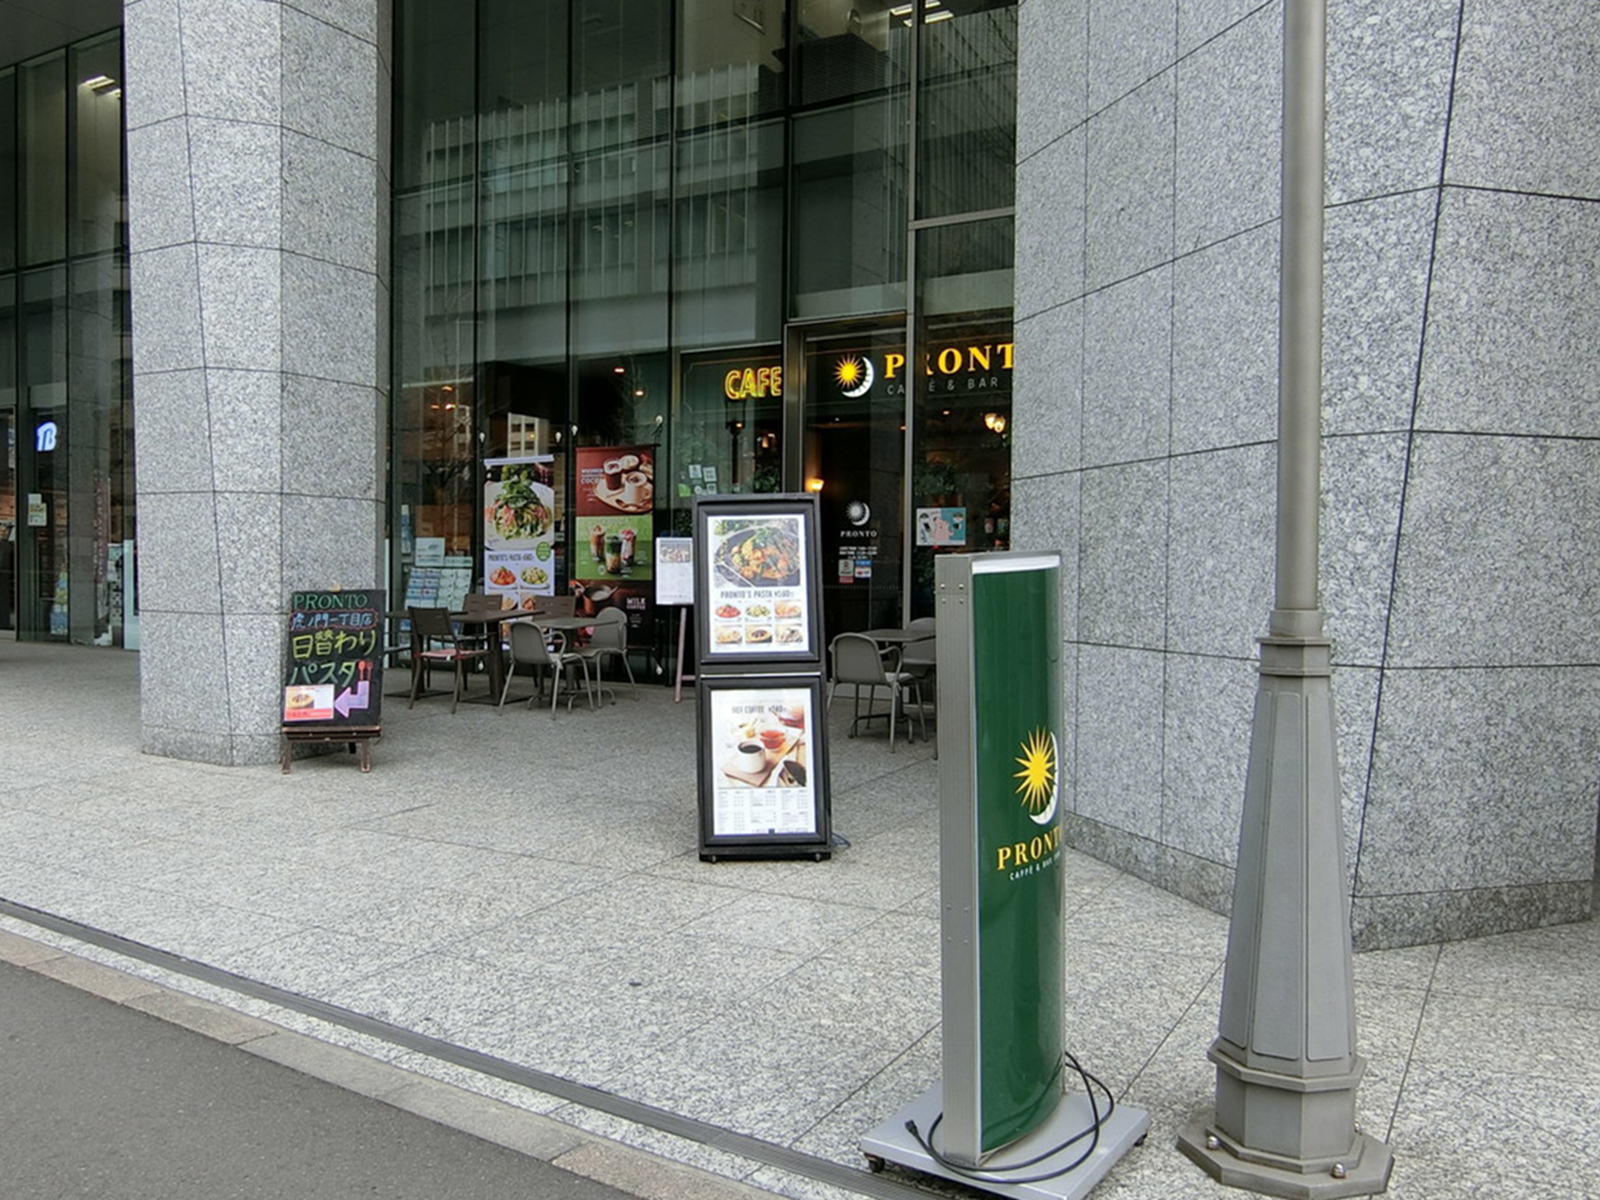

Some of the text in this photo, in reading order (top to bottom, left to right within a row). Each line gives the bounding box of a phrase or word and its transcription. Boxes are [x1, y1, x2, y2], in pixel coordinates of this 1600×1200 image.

[724, 365, 782, 400] CAFE
[968, 376, 999, 389] BAR
[840, 530, 878, 538] PRONTO
[720, 590, 752, 598] PRONTO'S
[753, 589, 773, 598] PASTA
[293, 594, 368, 609] PRONTO
[292, 629, 377, 659] 日替わり
[290, 661, 356, 688] パスタ
